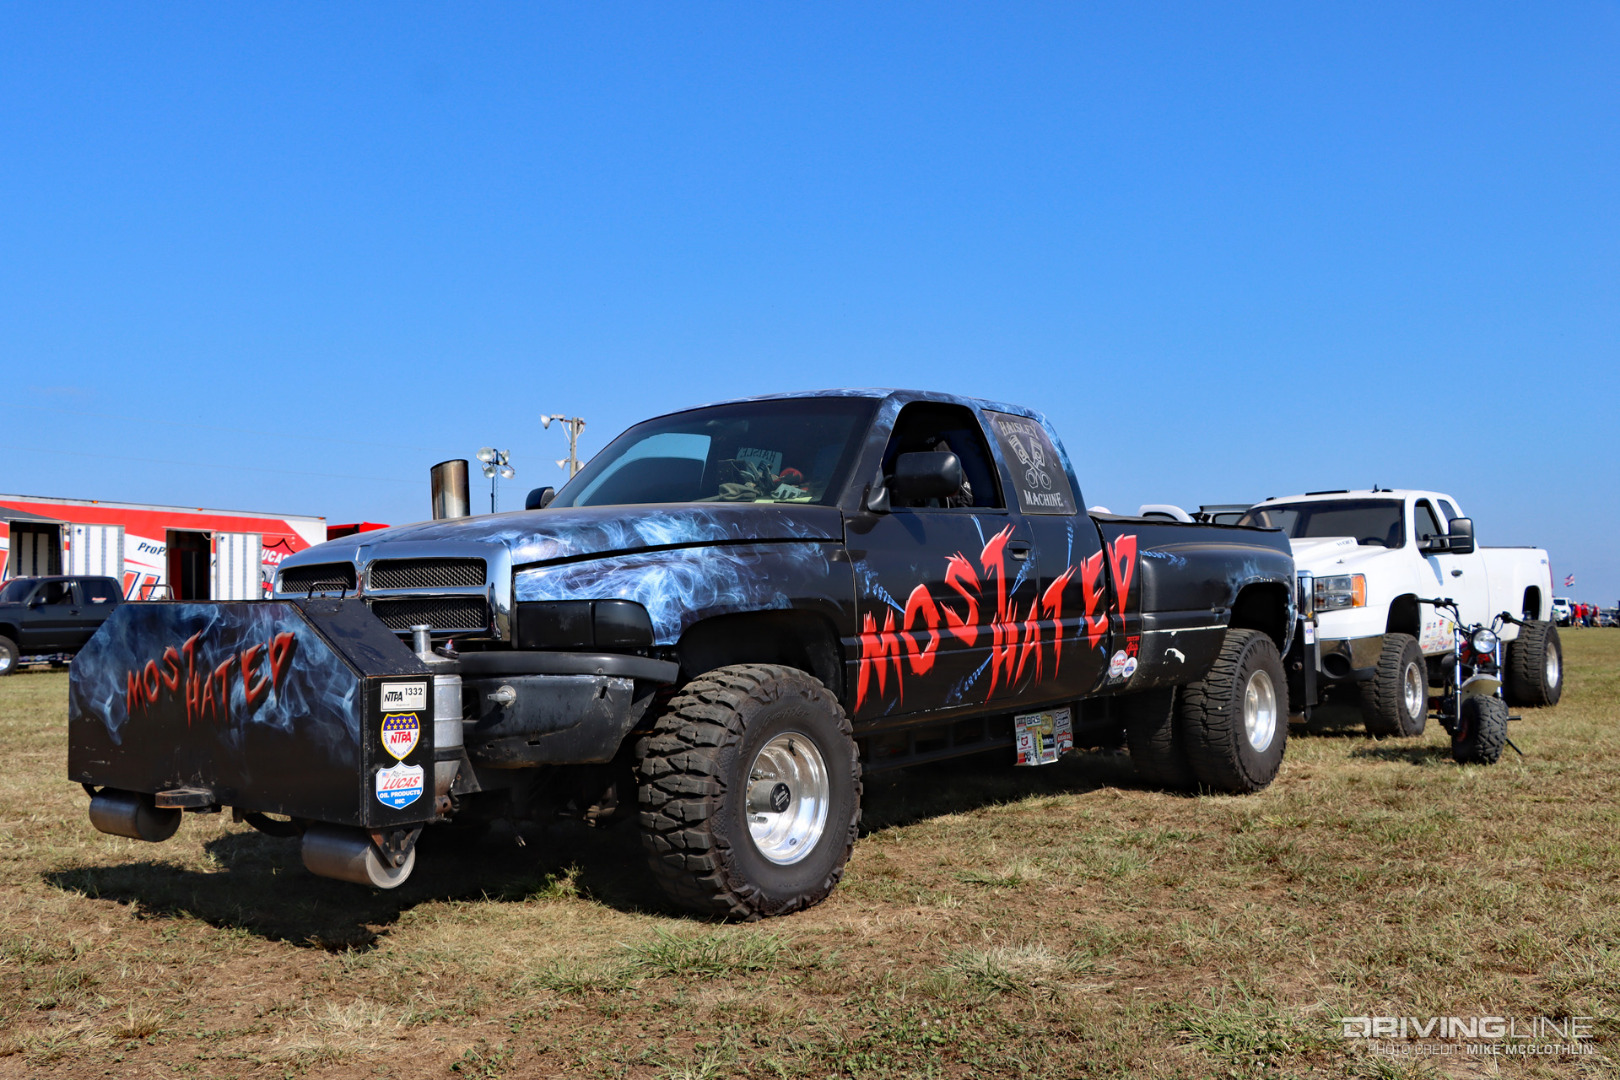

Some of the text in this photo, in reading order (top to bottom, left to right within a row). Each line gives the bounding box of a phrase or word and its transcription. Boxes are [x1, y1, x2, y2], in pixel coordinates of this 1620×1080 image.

[998, 421, 1040, 440] HAISLEY
[1023, 489, 1064, 507] MACHINE
[855, 523, 1015, 713] MOST
[984, 534, 1137, 704] HATED
[127, 630, 202, 716] MOST
[185, 632, 295, 727] HATED
[384, 687, 423, 702] NTPA 1332
[390, 731, 412, 744] NTPA
[382, 776, 421, 790] LUCAS
[379, 788, 421, 799] OIL PRODUCTS
